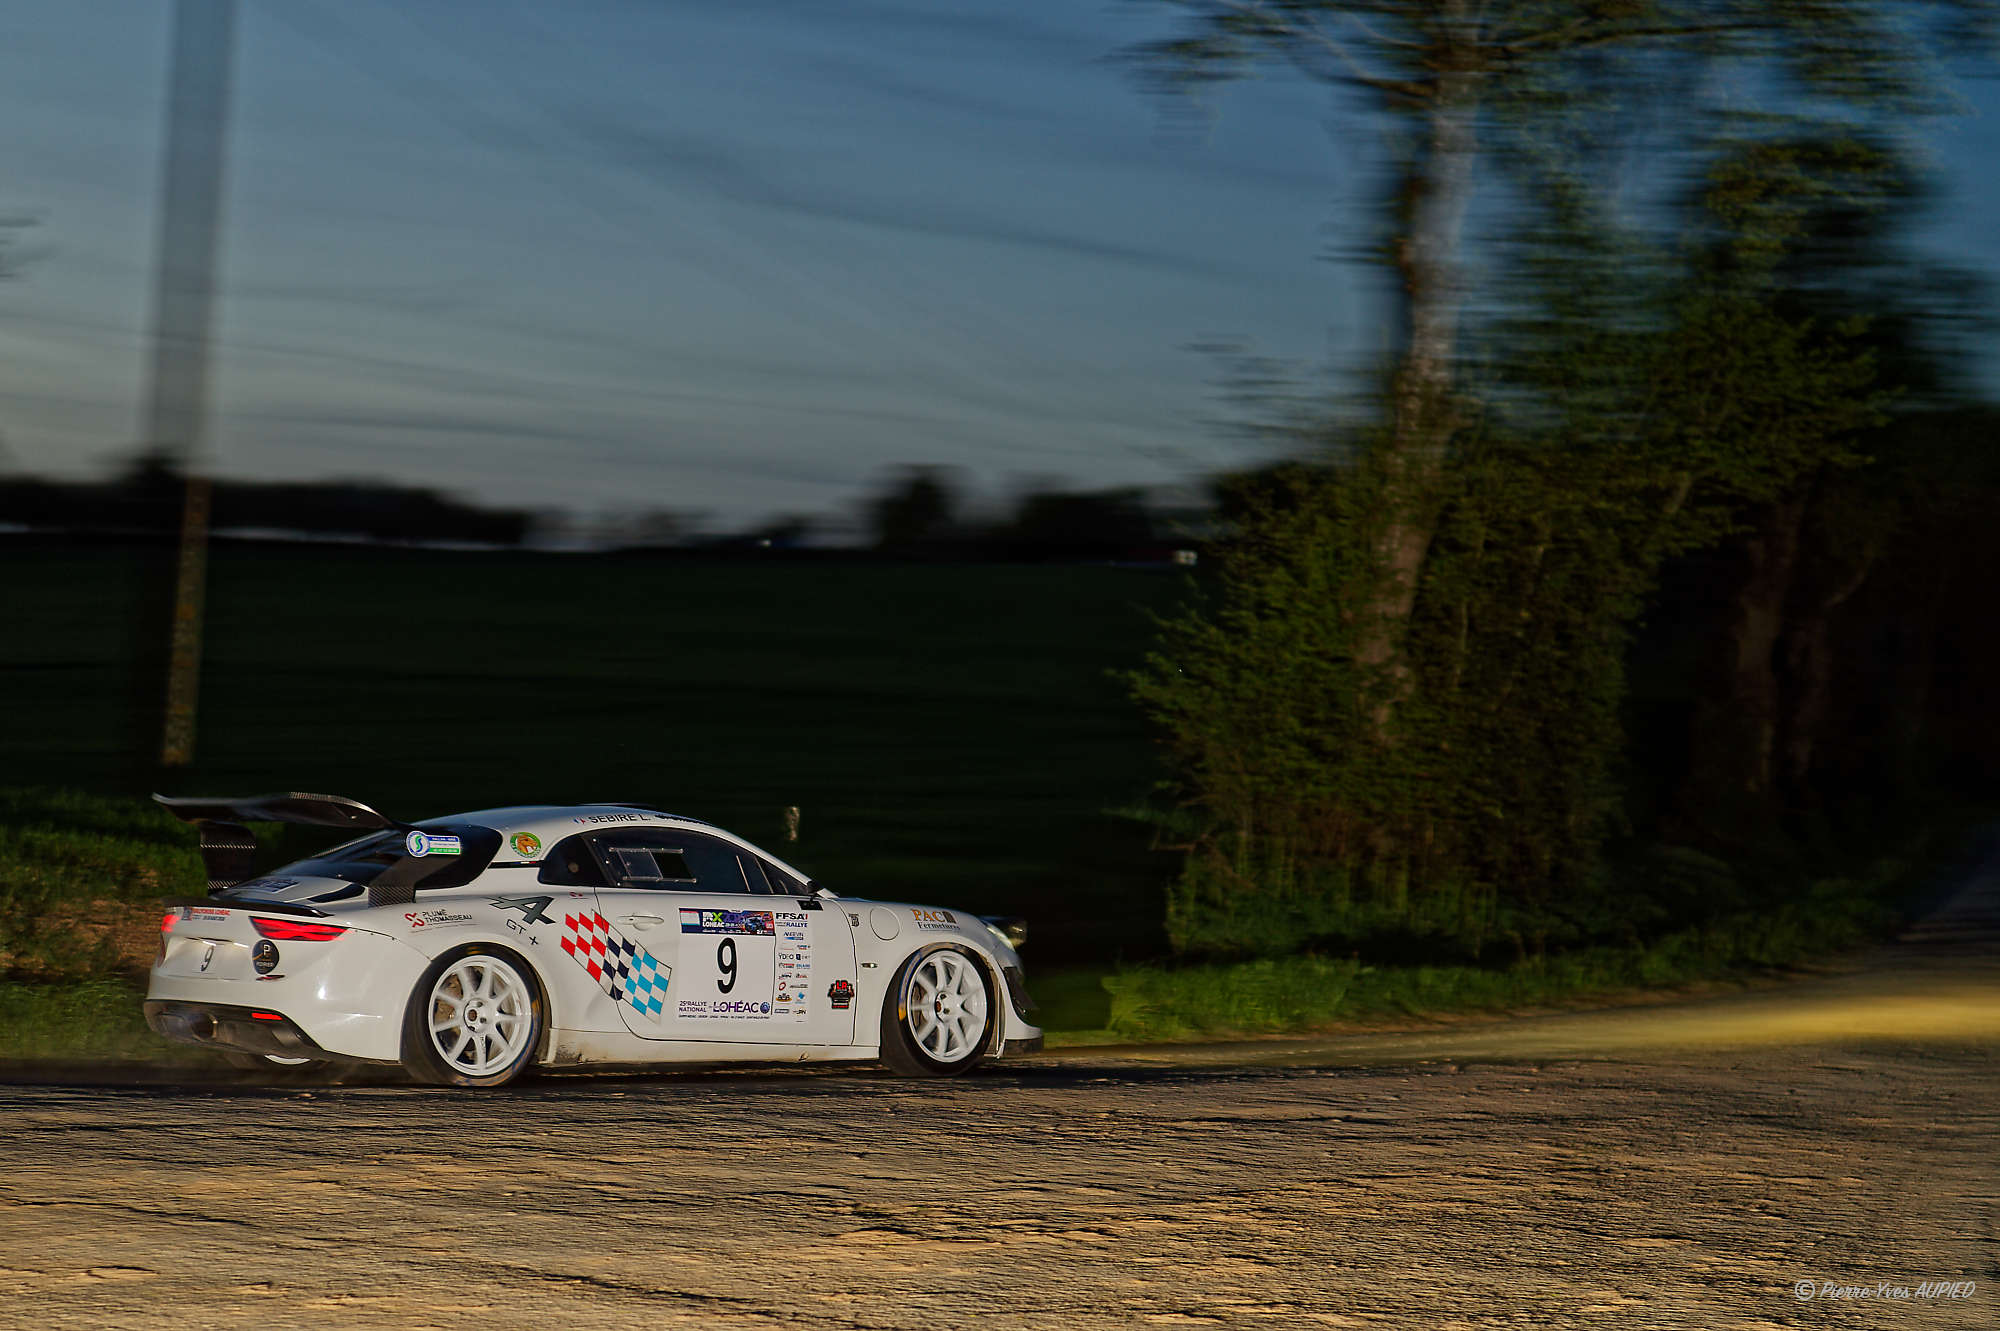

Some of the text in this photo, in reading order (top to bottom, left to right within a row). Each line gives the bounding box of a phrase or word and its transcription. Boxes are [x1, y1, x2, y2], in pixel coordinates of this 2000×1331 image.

[588, 813, 637, 824] SEBIRE
[424, 914, 473, 923] THOMASSEAU
[912, 909, 945, 923] PAC
[717, 937, 737, 994] 9
[835, 980, 848, 990] LR
[713, 1000, 759, 1013] LOHÉAC
